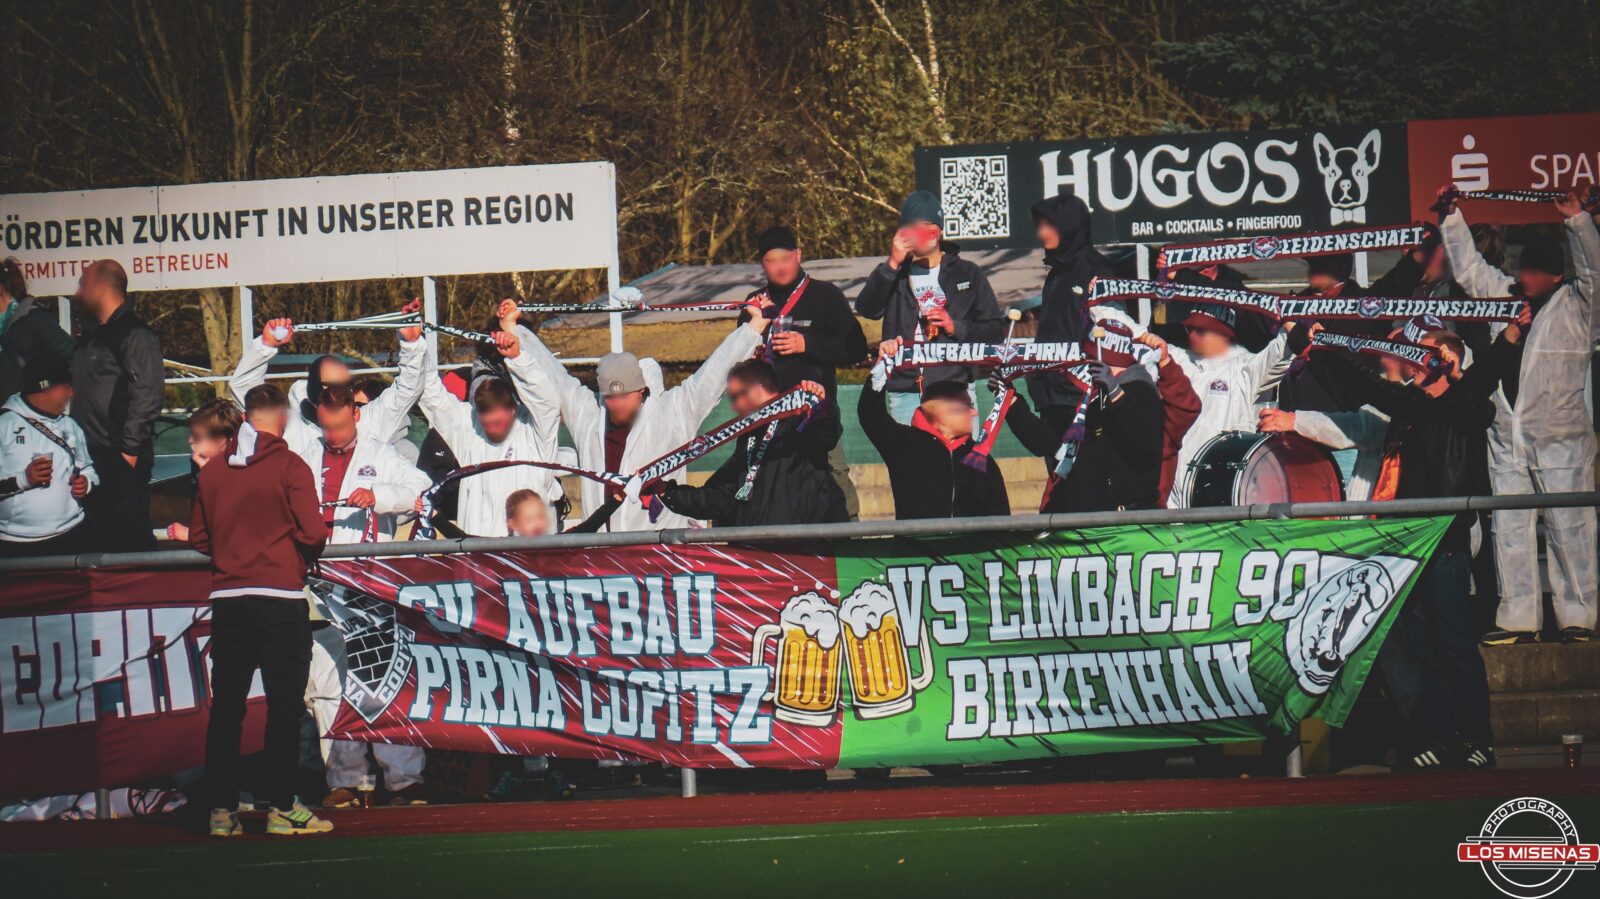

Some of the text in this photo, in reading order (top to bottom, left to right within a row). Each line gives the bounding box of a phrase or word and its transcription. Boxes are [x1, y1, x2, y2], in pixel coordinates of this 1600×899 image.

[1038, 140, 1300, 213] HUGOS
[1530, 152, 1600, 189] SPA
[0, 192, 574, 251] ÖRDERN ZUKUNFT IN UNSERER REGION
[1132, 214, 1302, 236] BAR COCKTAILS FINGERFOOD
[132, 252, 229, 274] BETREUEN
[1187, 242, 1251, 263] JAHRE
[1280, 226, 1423, 254] LEIDENSCHAFT
[1177, 283, 1280, 314] LEIDENSCHA
[1300, 299, 1358, 316] JAHRE
[1385, 299, 1523, 319] LEIDENSCHAFT
[911, 342, 985, 365] AUFBAU
[1023, 341, 1080, 362] PIRNA
[39, 379, 50, 389] TR
[15, 435, 25, 444] TR
[502, 573, 718, 656] AUFBAU
[886, 549, 1318, 647] VS LIMBACH 90
[408, 643, 566, 731] PIRNA
[945, 638, 1268, 740] BIRKENHAIN
